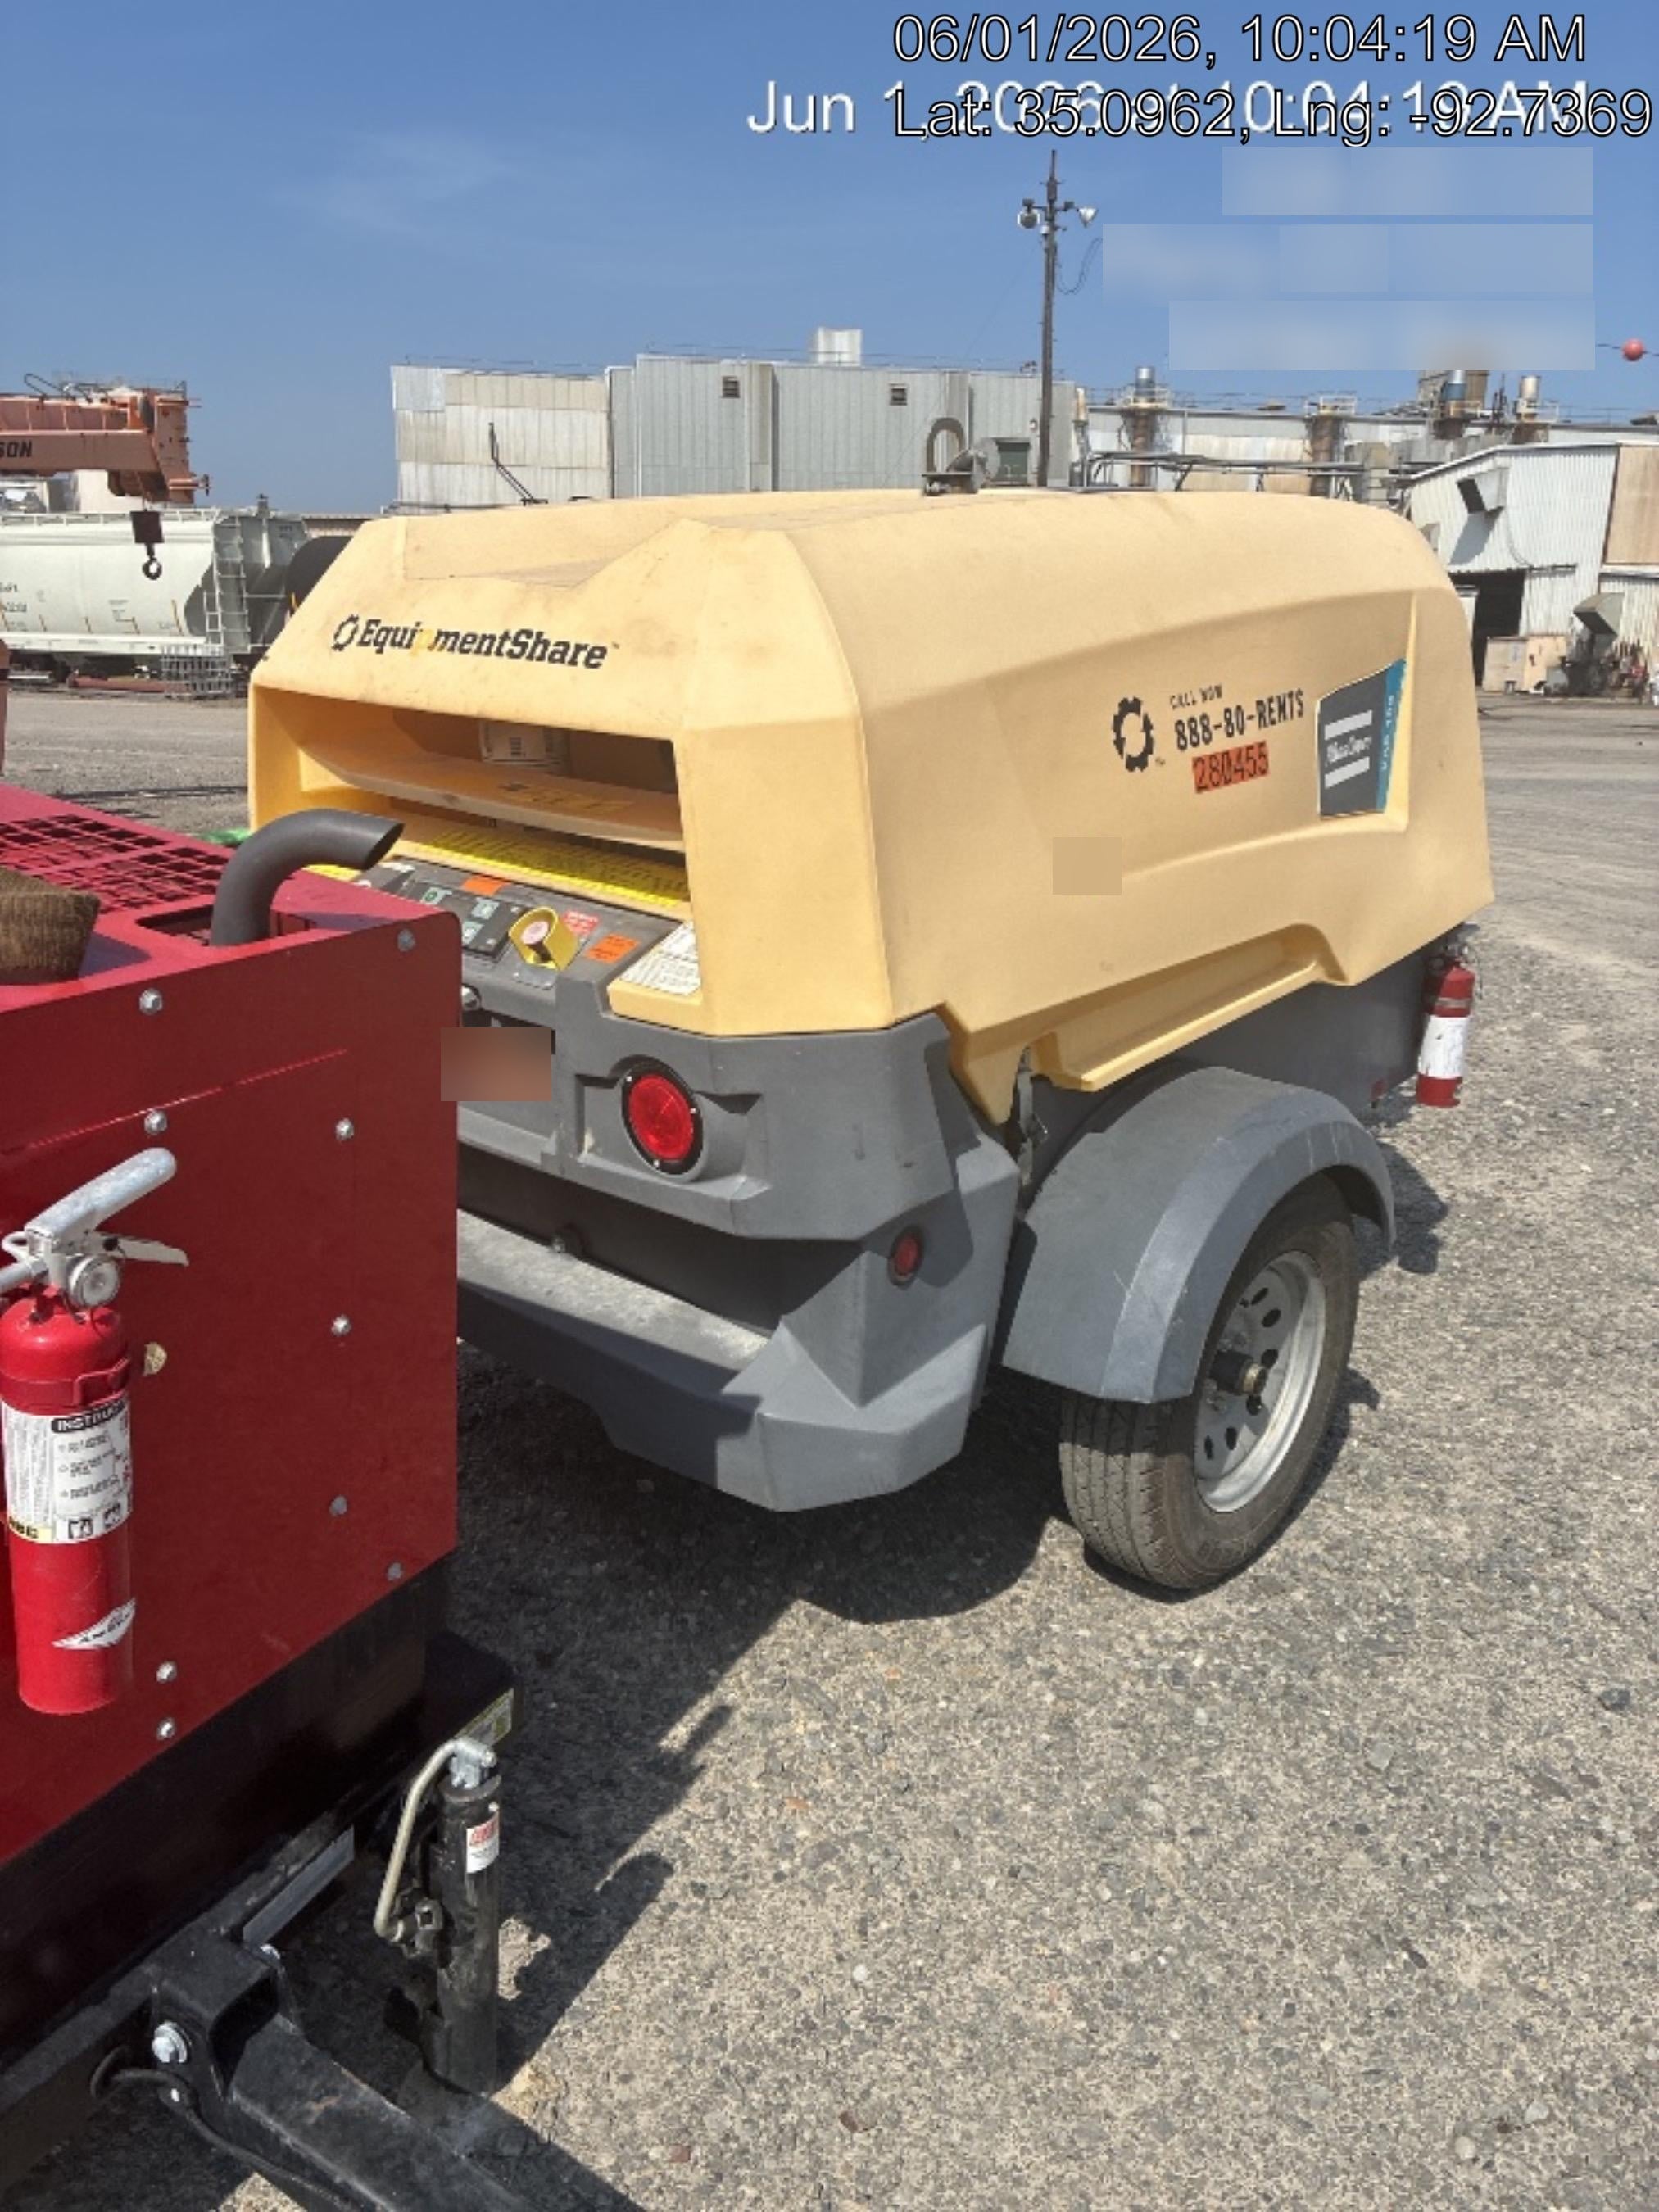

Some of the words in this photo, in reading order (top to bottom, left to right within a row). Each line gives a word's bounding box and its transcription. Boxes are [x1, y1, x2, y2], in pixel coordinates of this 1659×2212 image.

[357, 619, 608, 669] EquimentShare
[1175, 687, 1304, 752] 888-80-RENTS
[1193, 741, 1268, 793] 280455
